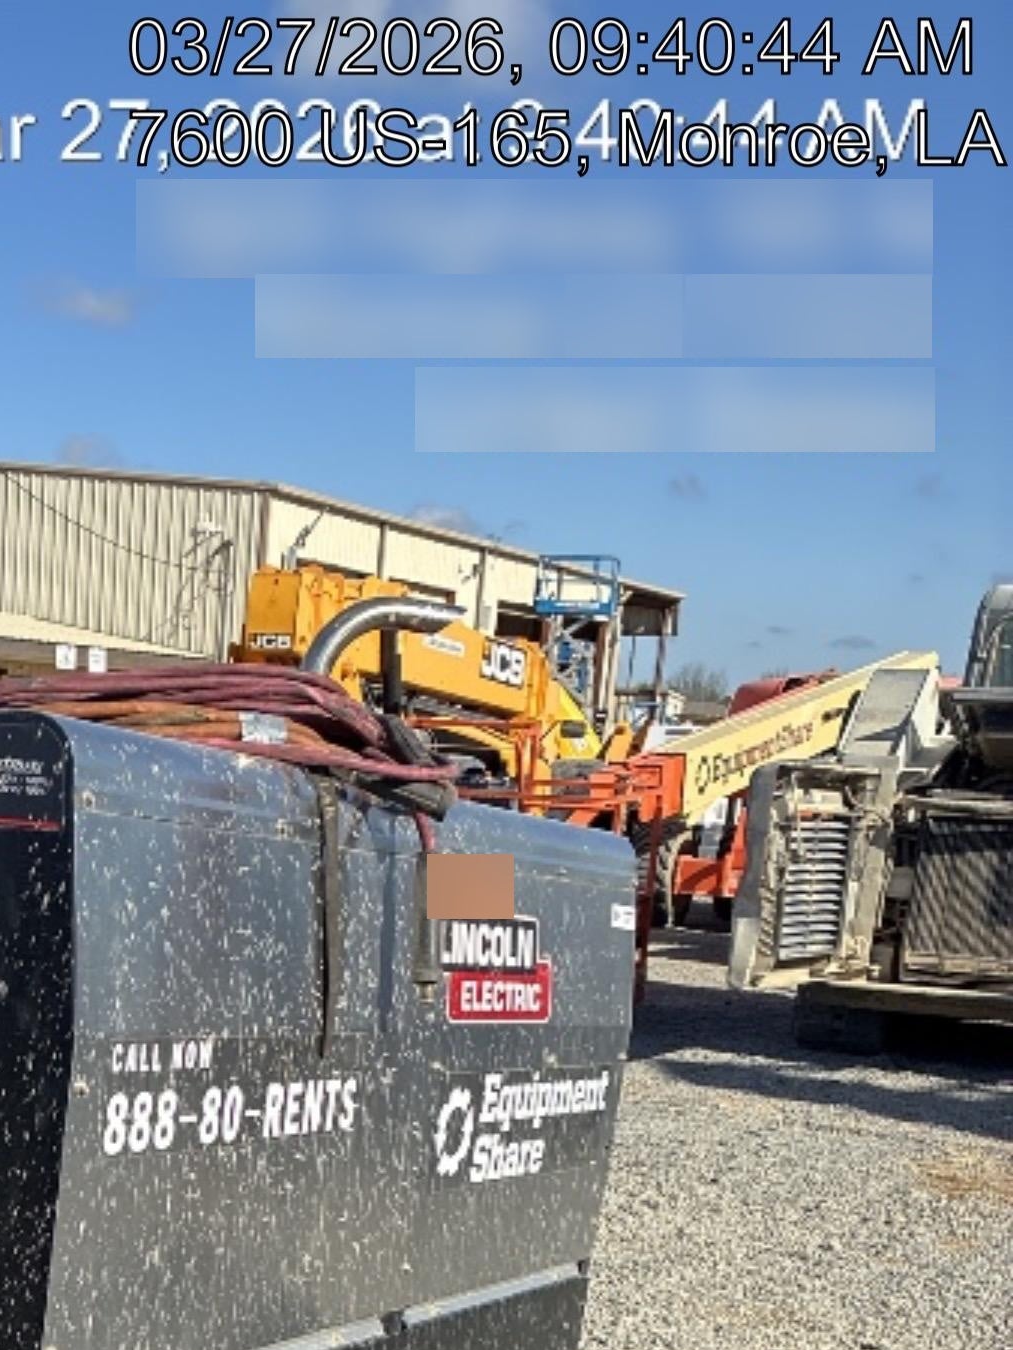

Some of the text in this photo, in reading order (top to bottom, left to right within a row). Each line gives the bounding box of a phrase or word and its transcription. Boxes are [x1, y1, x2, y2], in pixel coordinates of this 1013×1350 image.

[250, 635, 291, 650] JCB
[481, 642, 527, 687] JCB
[440, 921, 535, 970] LINCOLN
[460, 979, 543, 1013] ELECTRIC
[112, 1039, 215, 1073] CALL NOW
[103, 1077, 359, 1156] 888-80-RENTS
[478, 1070, 610, 1132] Equipment
[469, 1132, 546, 1183] Share
